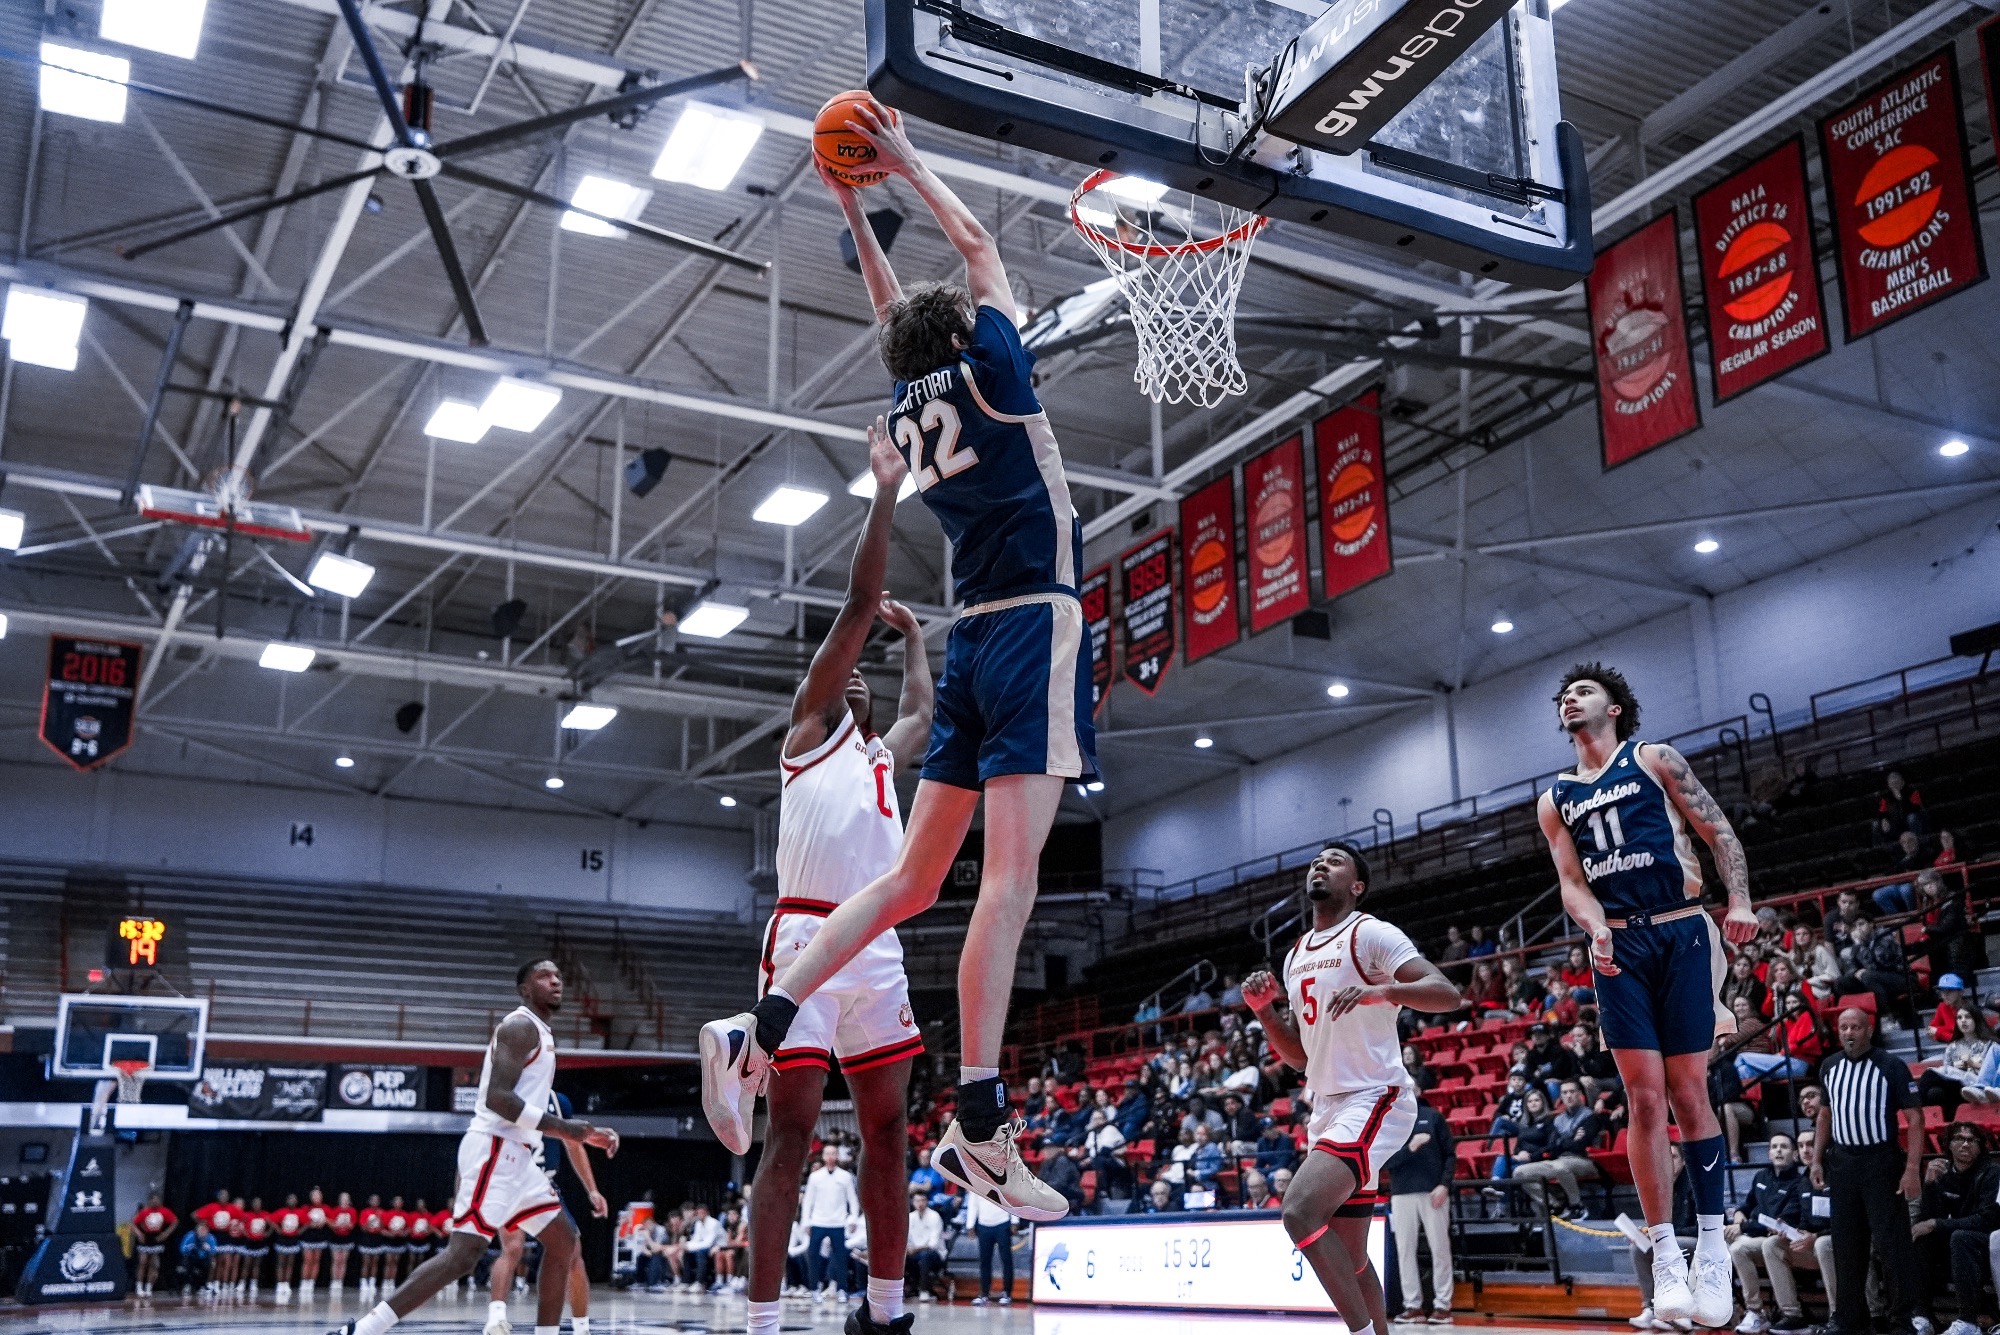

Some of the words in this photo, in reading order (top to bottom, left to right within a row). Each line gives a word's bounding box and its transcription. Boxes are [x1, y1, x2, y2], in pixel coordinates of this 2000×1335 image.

[1831, 104, 1873, 140] SOUTH
[1880, 65, 1942, 113] ATLANTIC
[1846, 93, 1929, 150] CONFERENCE
[1874, 127, 1904, 155] SAC
[1730, 183, 1767, 213] NAIA
[1865, 170, 1932, 220] 1991-92
[1715, 201, 1769, 252] DISTRICT
[1858, 208, 1951, 270] CHAMPIONS
[1728, 252, 1788, 295] 1987-88
[1870, 267, 1953, 318] BASKETBALL
[1886, 256, 1931, 291] MEN'S
[1728, 290, 1799, 341] CHAMPIONS
[1719, 341, 1769, 375] REGULAR
[1771, 315, 1818, 350] SEASON
[1614, 369, 1678, 415] CHAMPIONS
[895, 397, 980, 493] 22
[1129, 551, 1166, 601] 1969
[62, 651, 127, 687] 2016
[1561, 781, 1641, 827] Charleston
[290, 822, 314, 847] 14
[1587, 805, 1627, 852] 11
[580, 848, 604, 872] 15
[1582, 848, 1655, 884] Southern
[119, 919, 166, 941] 15:32
[1301, 976, 1318, 1026] 5
[372, 1087, 417, 1108] BAND
[373, 1070, 406, 1088] PEP
[1086, 1249, 1096, 1279] 6
